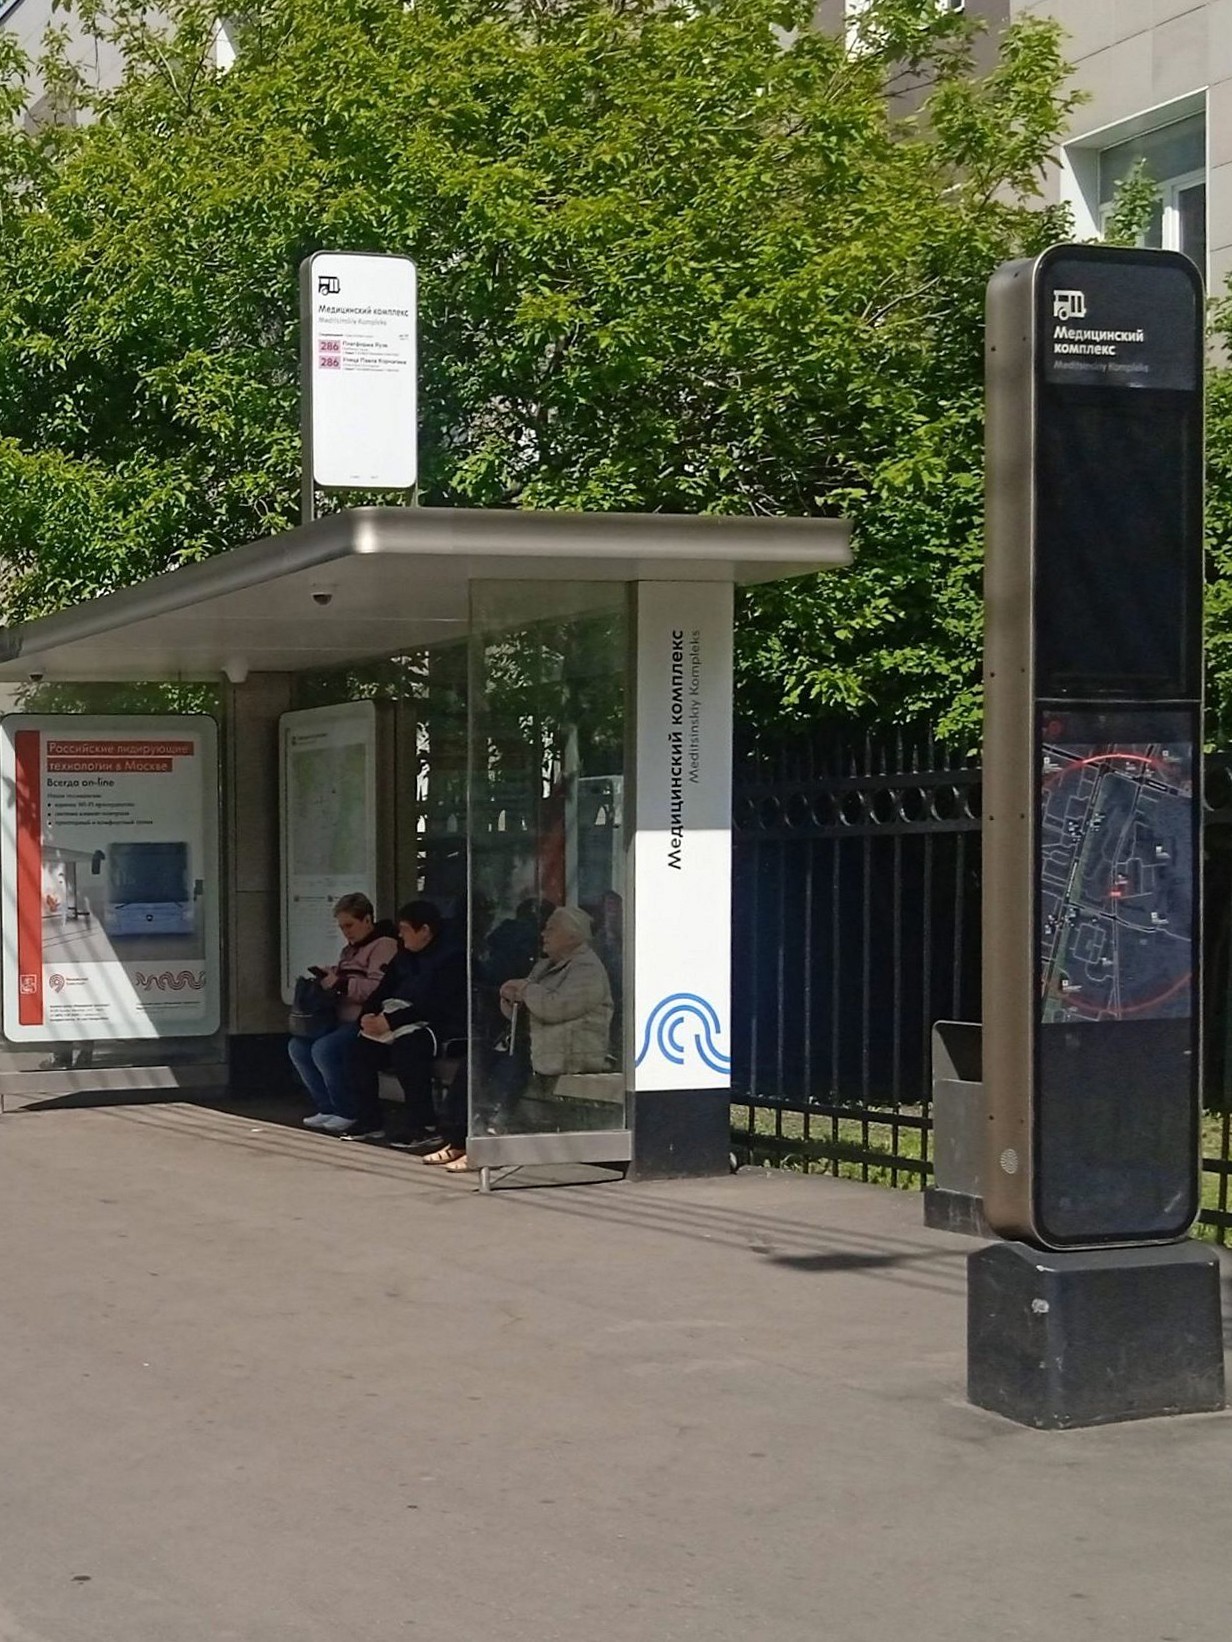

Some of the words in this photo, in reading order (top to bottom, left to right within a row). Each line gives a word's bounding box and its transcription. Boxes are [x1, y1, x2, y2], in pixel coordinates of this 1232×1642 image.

[1053, 326, 1144, 342] Медицинский
[320, 341, 339, 351] 286
[1053, 343, 1117, 356] комплекс
[320, 357, 339, 367] 286
[688, 629, 701, 696] Kompleks
[671, 629, 684, 726] комплекс
[49, 743, 114, 754] Российские
[688, 700, 701, 784] Meditsinskiy
[49, 762, 113, 771] технологии
[124, 760, 168, 771] Москве
[47, 778, 79, 787] Всегда
[81, 777, 115, 787] on-line
[668, 731, 684, 870] Медицинский
